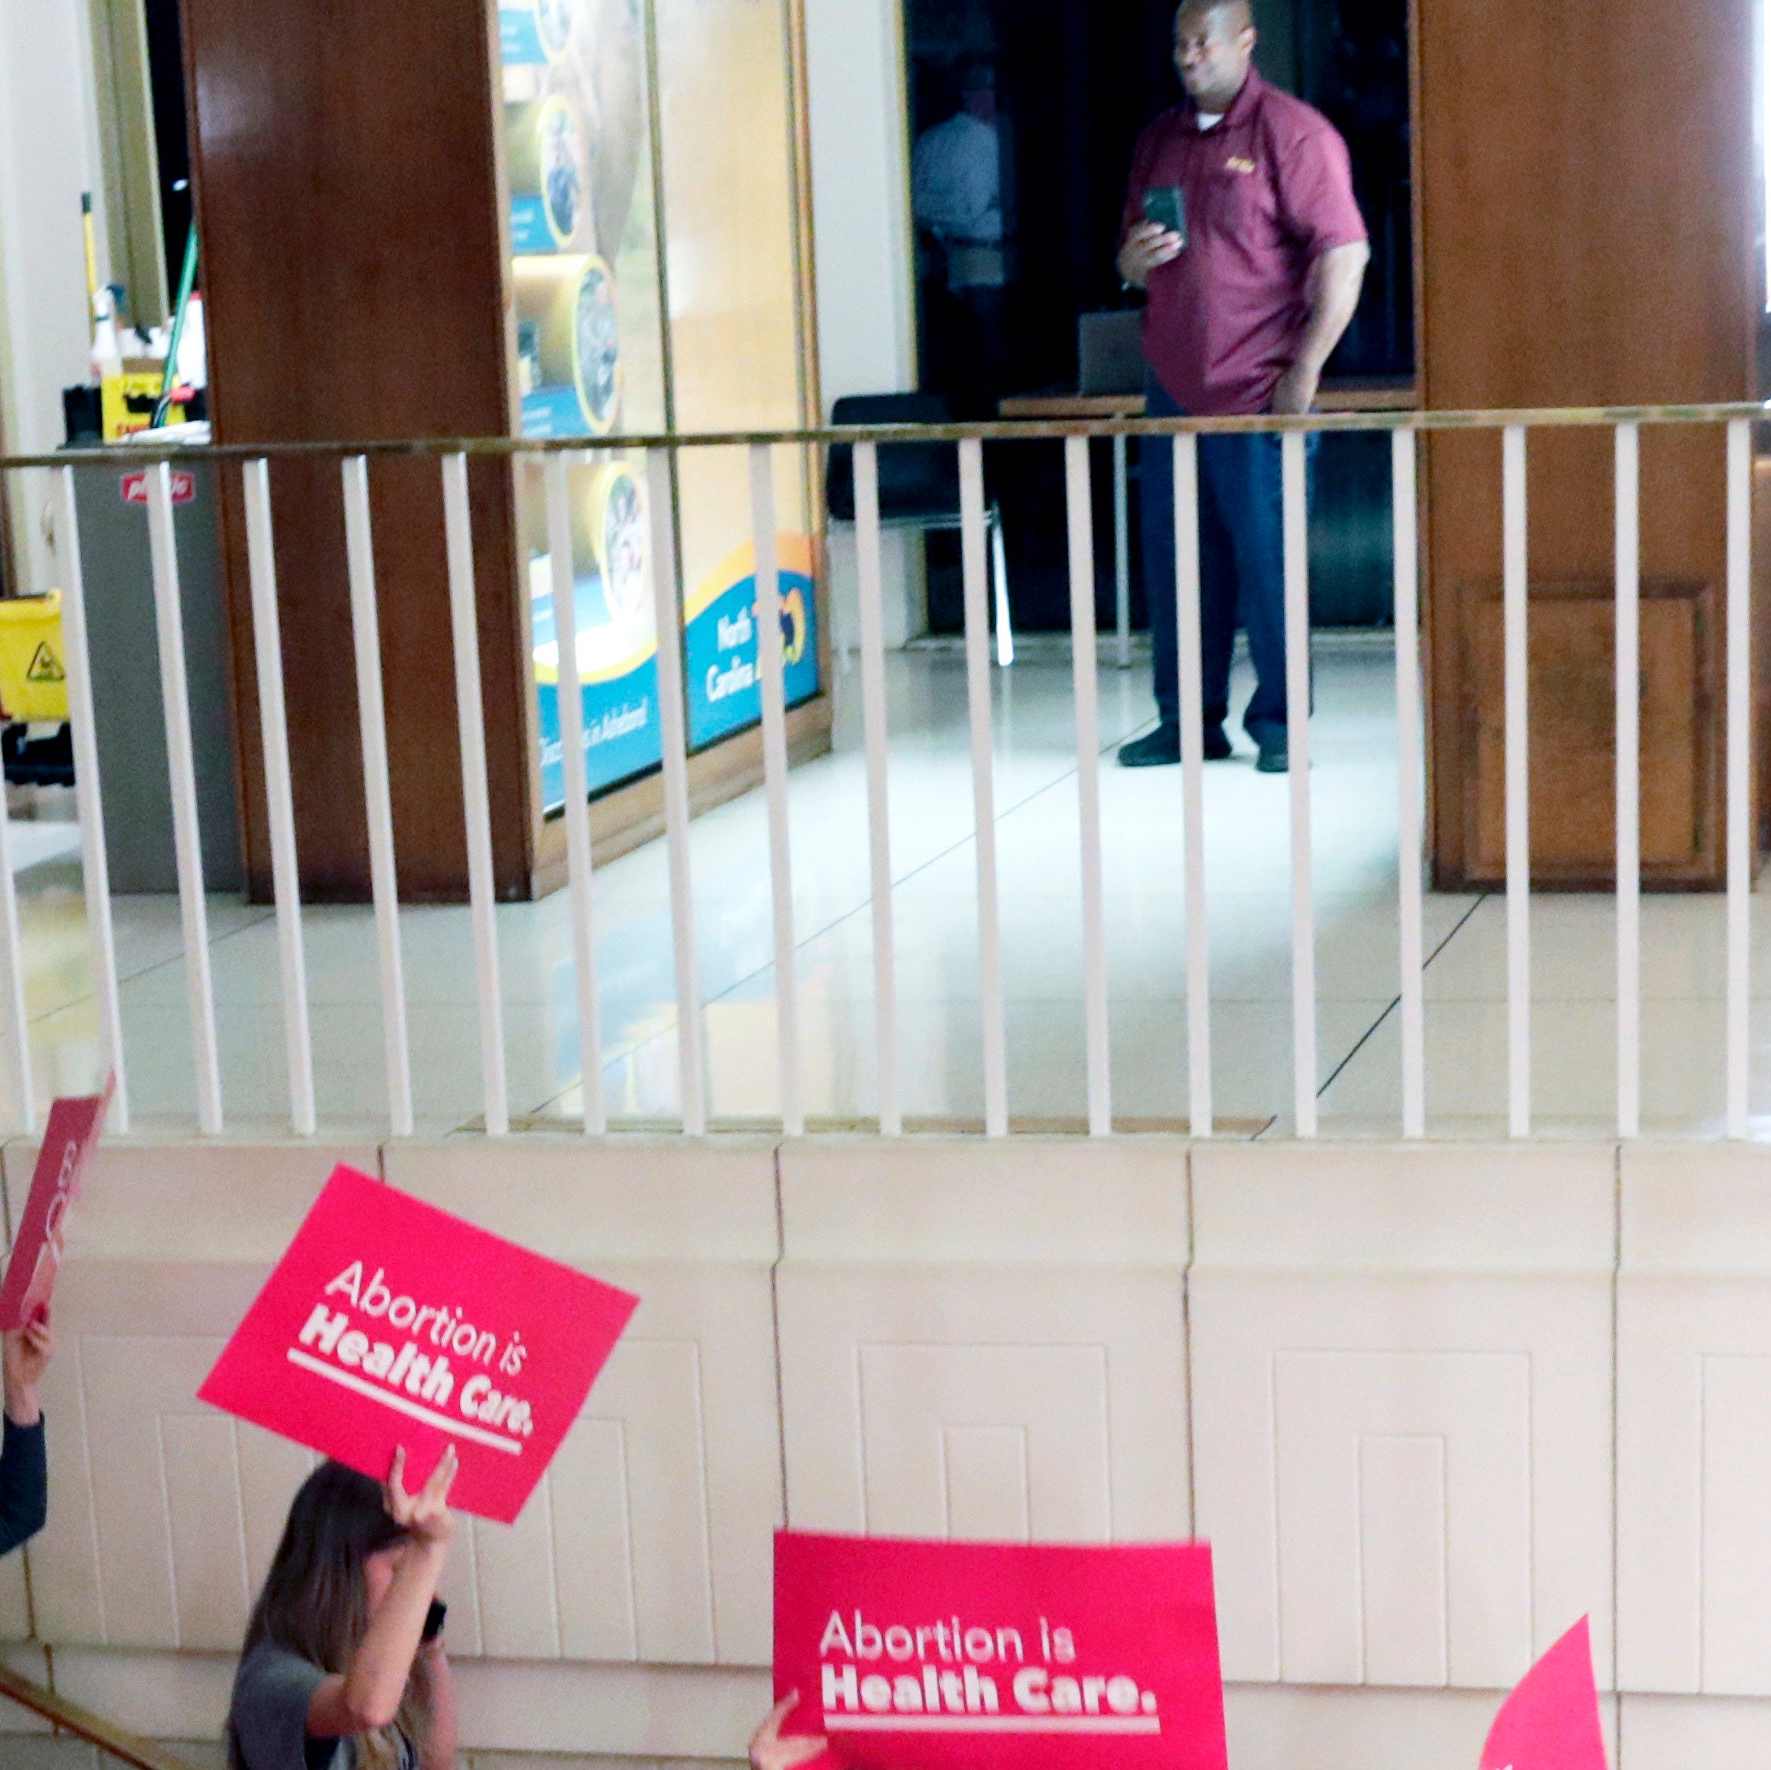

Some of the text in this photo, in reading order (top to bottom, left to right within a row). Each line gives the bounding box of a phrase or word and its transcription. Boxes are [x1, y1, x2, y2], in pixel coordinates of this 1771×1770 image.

[324, 1260, 528, 1376] Abortion is
[298, 1302, 534, 1437] Health Care.
[818, 1608, 1077, 1665] Abortion is
[820, 1662, 1159, 1715] Health Care.
